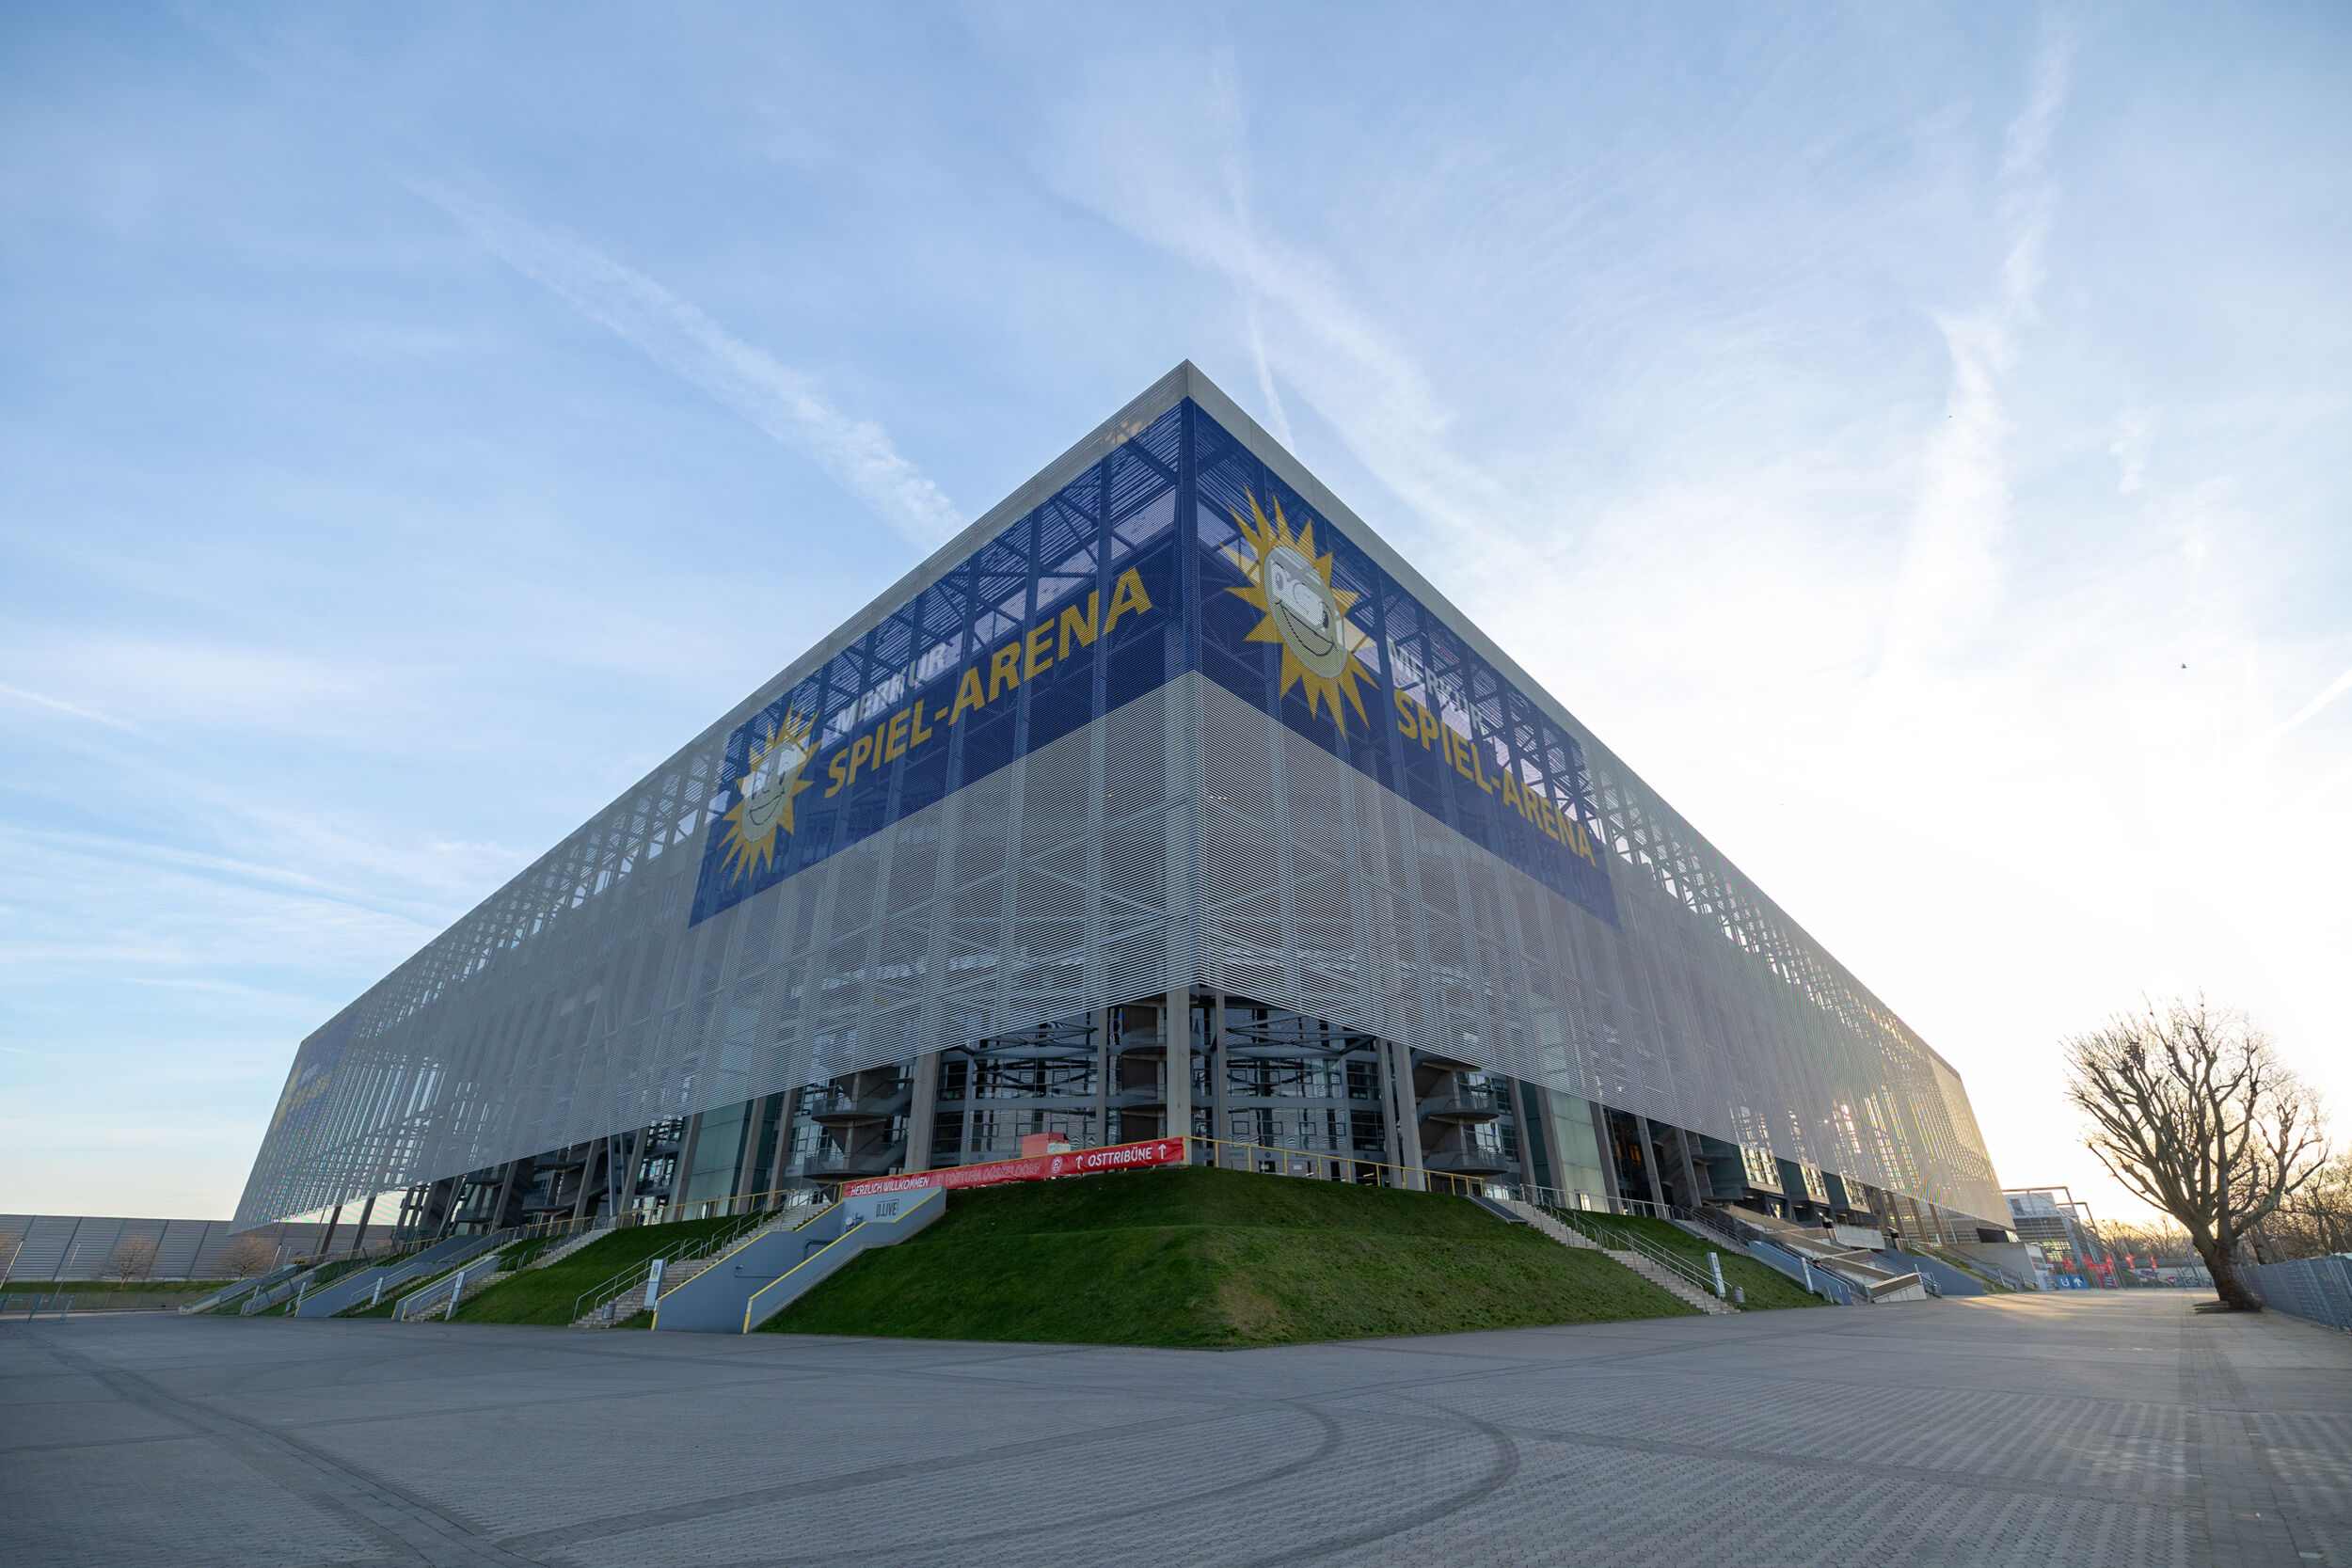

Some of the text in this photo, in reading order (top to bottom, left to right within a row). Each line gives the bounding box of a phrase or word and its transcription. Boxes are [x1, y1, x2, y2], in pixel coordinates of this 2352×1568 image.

[824, 566, 1152, 800] SPIEL-ARENA
[835, 642, 946, 735] MERKUR
[1386, 635, 1485, 733] MERKUR
[1393, 689, 1597, 868] SPIEL-ARENA
[850, 1182, 882, 1196] HERZLICH
[883, 1177, 930, 1192] WILLKOMMEN
[930, 1173, 944, 1186] BEI
[946, 1168, 981, 1185] FORTUNA
[983, 1162, 1041, 1180] DÜSSELDORF
[1088, 1146, 1152, 1167] OSTTRIBÜNE
[875, 1201, 898, 1218] D.LIVE
